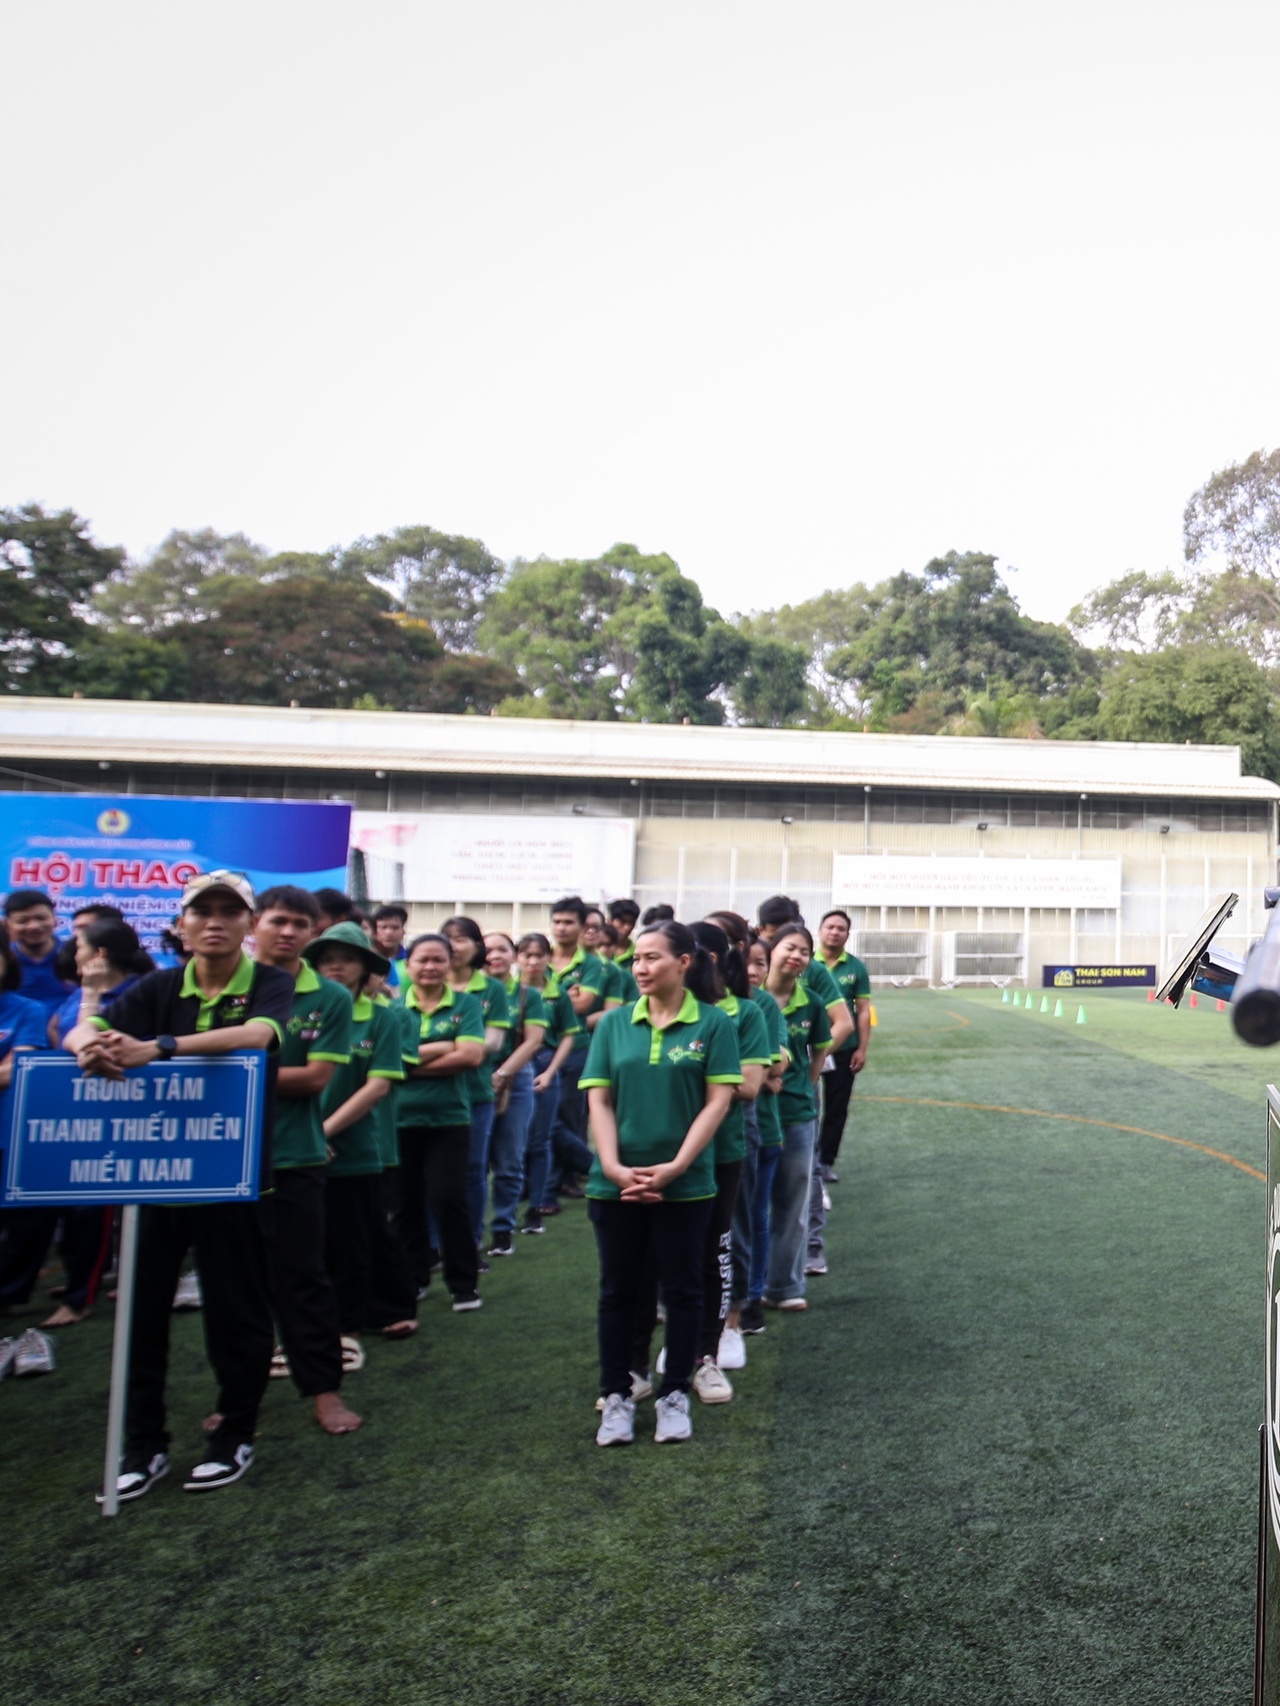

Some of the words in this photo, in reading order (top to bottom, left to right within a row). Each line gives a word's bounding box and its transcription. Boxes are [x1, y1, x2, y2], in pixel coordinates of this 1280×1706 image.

[12, 852, 84, 893] HỘI
[91, 858, 199, 888] THAO
[1123, 967, 1147, 977] NAM
[72, 1077, 146, 1102] TRUNG
[153, 1073, 205, 1101] TÂM
[27, 1118, 103, 1143] THANH
[110, 1110, 178, 1142] THIẾU
[184, 1112, 241, 1141] NIÊN
[138, 1157, 193, 1182] NAM
